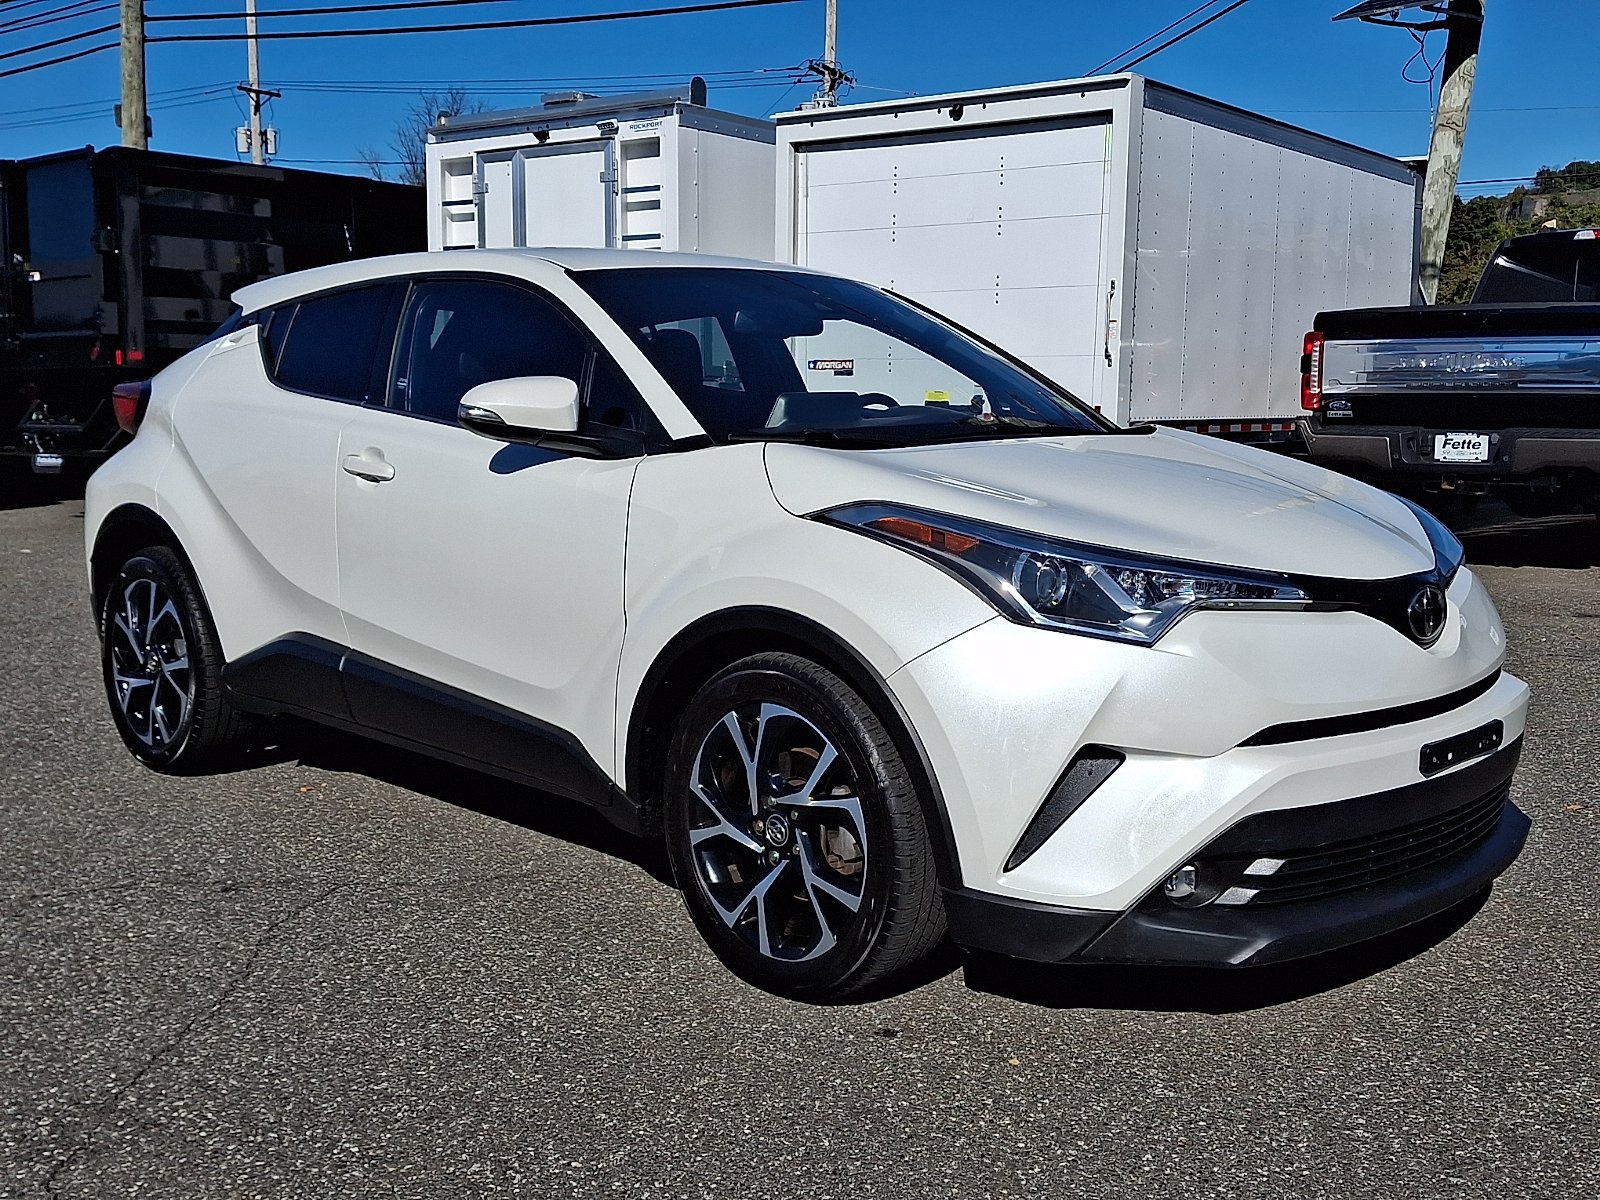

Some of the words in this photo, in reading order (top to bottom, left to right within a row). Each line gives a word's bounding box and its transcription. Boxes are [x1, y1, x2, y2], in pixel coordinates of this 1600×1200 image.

[629, 121, 663, 130] ROCKPORT
[815, 361, 853, 370] MORGAN
[1441, 438, 1482, 450] Fette
